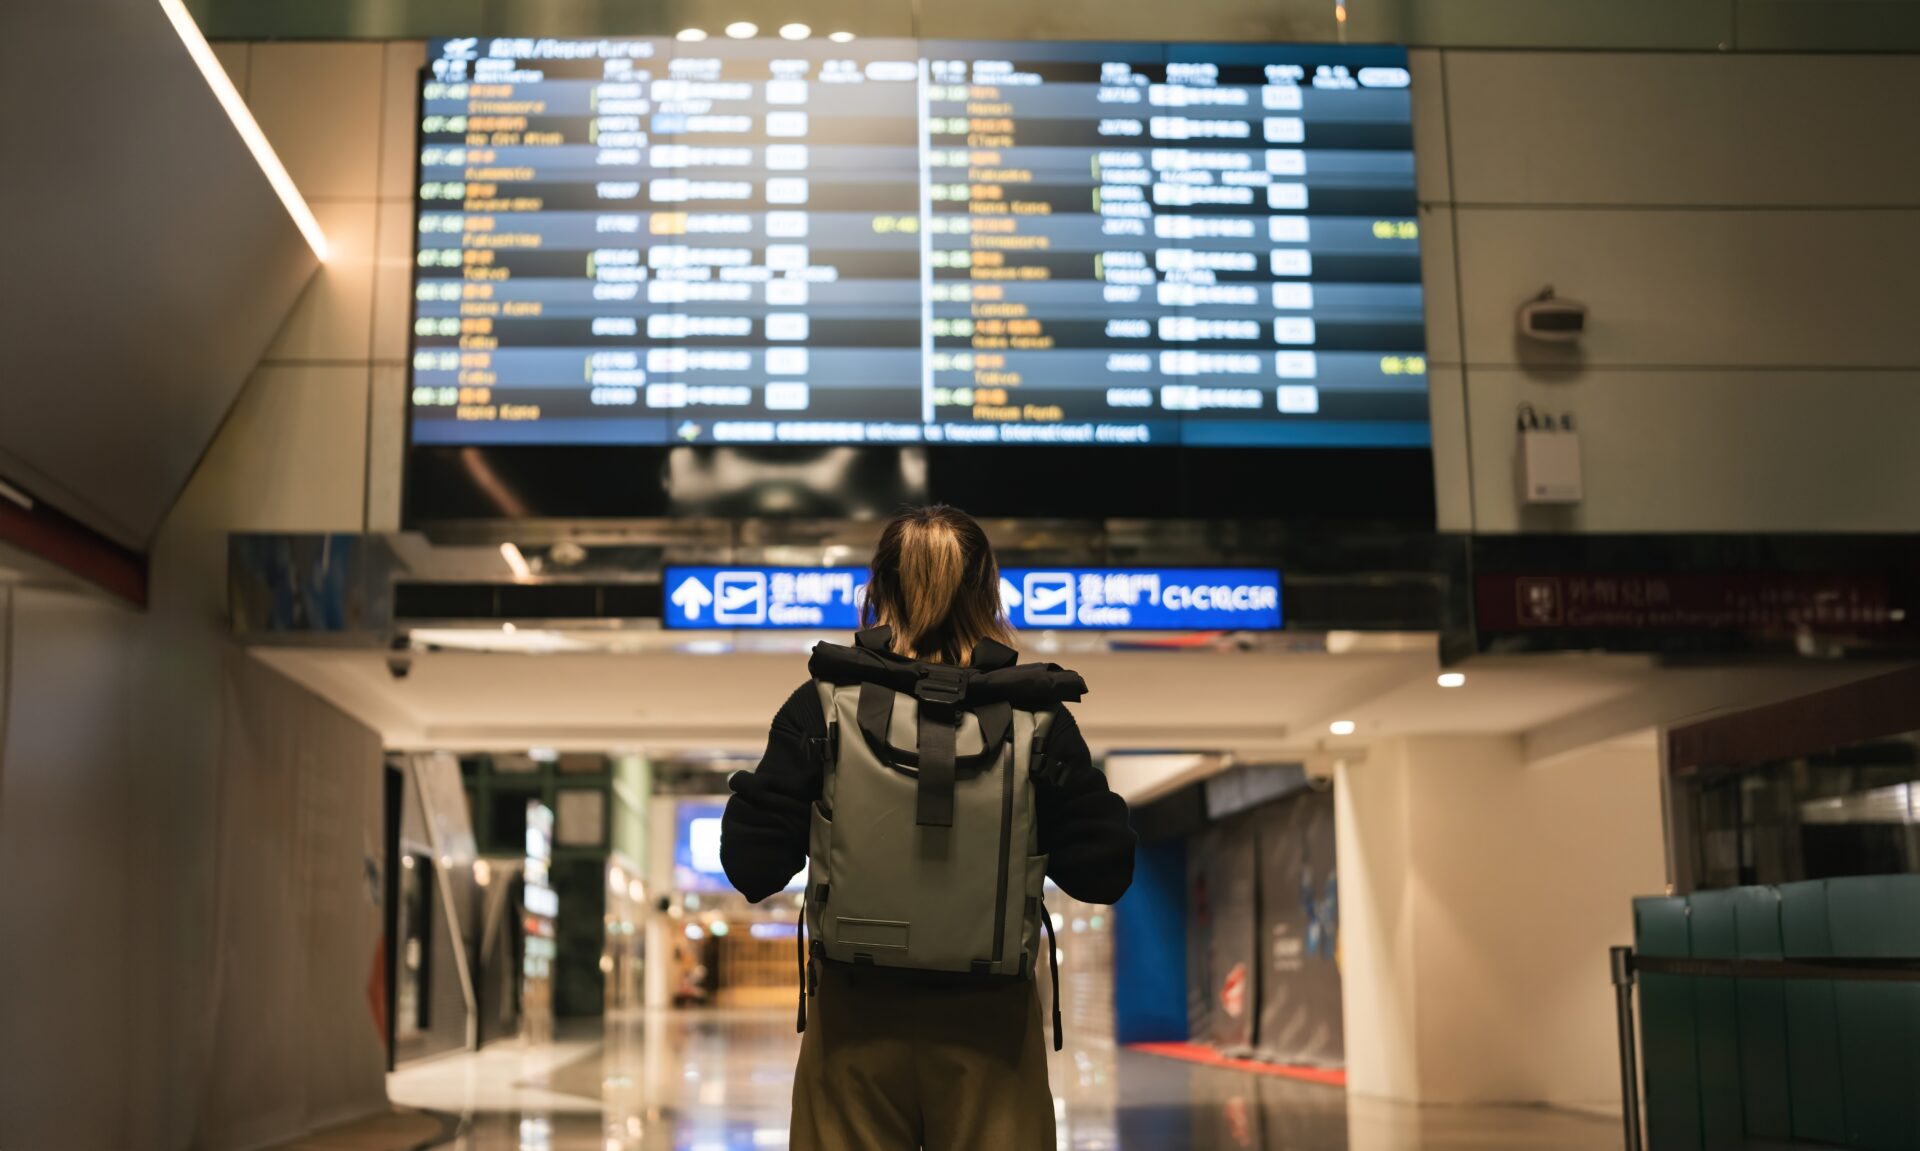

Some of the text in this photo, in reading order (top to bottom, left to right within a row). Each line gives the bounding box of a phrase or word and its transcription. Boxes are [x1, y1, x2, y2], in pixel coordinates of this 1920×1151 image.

[1000, 424, 1094, 442] International
[1095, 424, 1149, 442] Airport
[1079, 573, 1160, 606] 登機門
[1078, 603, 1132, 626] Gates
